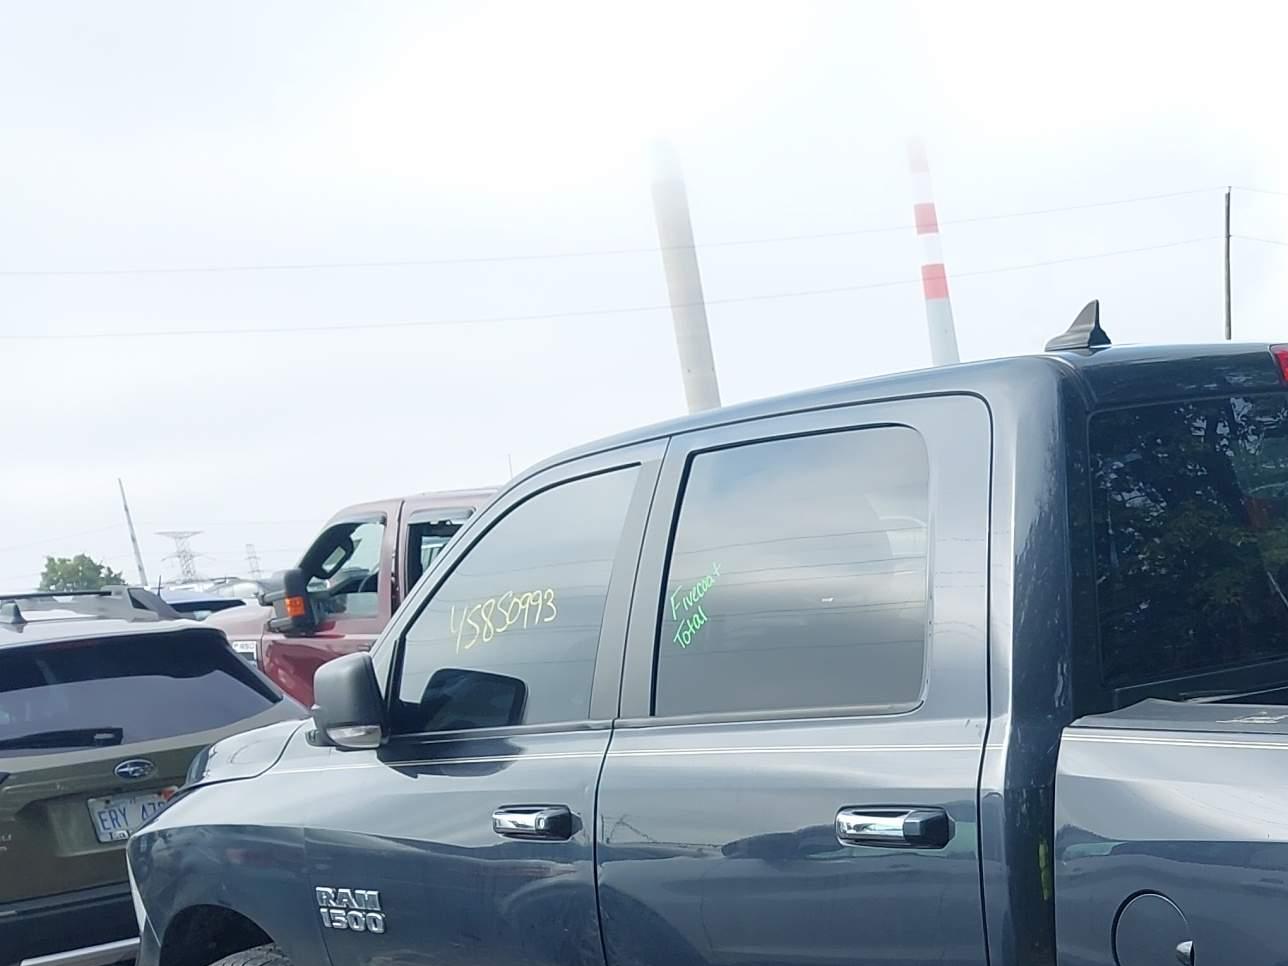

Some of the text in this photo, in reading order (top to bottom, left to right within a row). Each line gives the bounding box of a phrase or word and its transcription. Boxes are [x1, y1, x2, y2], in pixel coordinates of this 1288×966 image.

[449, 587, 557, 654] 45850993
[673, 606, 708, 649] Total
[97, 807, 129, 831] ERY
[315, 886, 381, 911] RAM
[320, 908, 385, 933] 1500
